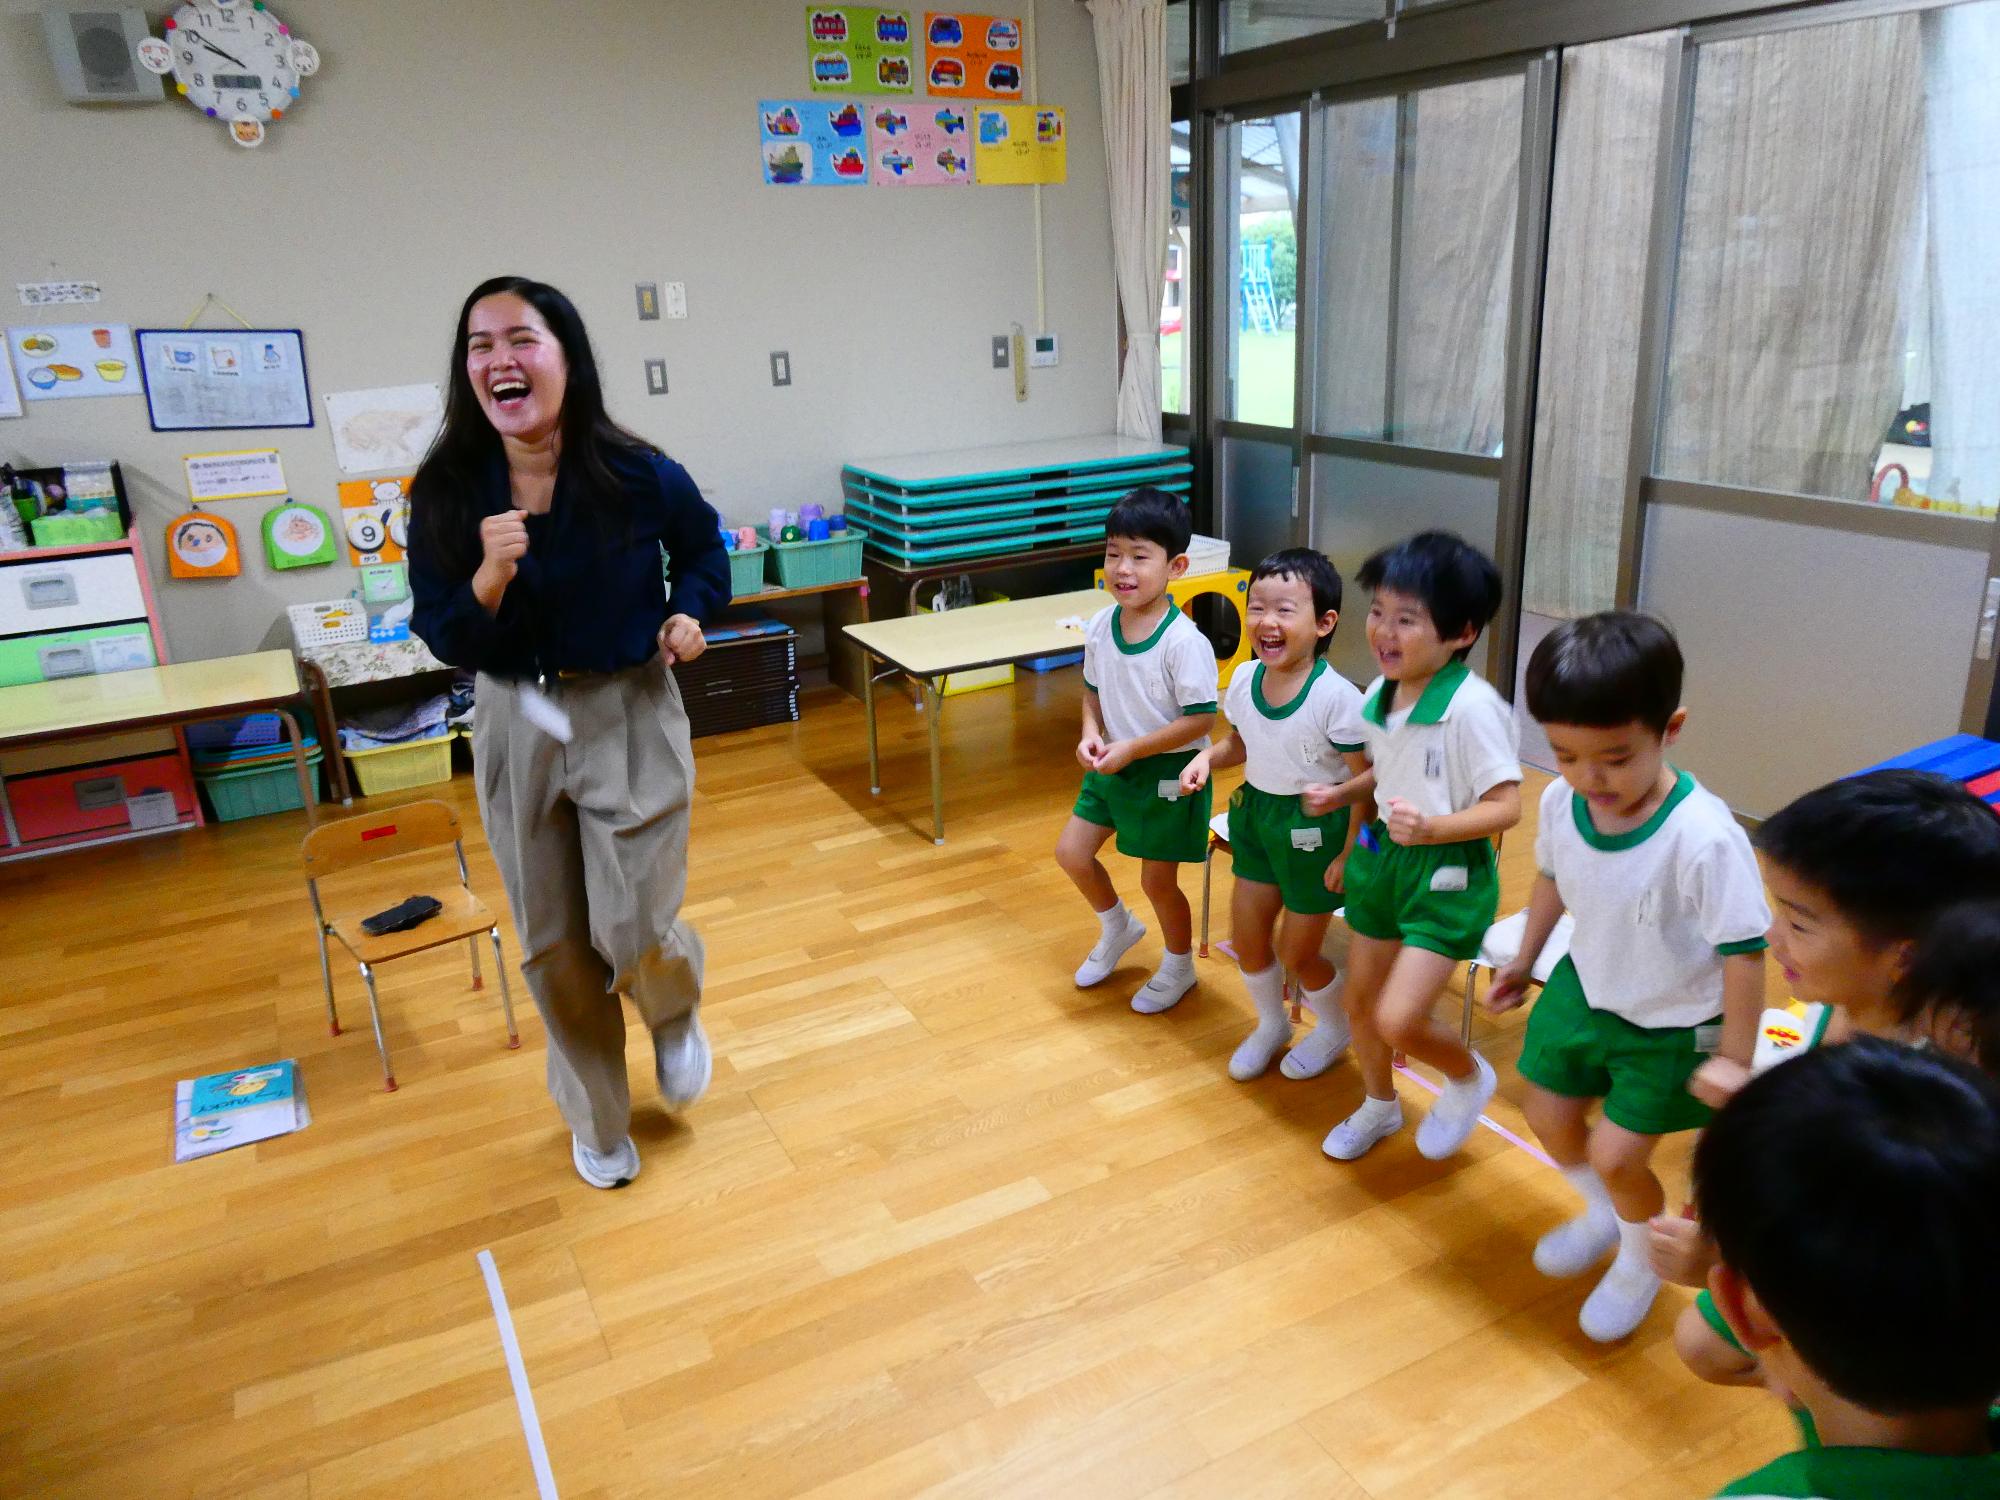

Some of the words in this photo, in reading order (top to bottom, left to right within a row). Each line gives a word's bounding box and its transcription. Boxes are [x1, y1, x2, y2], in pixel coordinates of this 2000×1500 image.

[198, 13, 212, 27] 11
[221, 8, 235, 23] 12
[248, 16, 255, 29] 1
[184, 29, 200, 44] 10
[264, 32, 274, 47] 2
[182, 50, 193, 65] 9
[275, 54, 285, 69] 3
[193, 73, 204, 87] 8
[271, 76, 281, 89] 4
[213, 90, 222, 105] 7
[236, 98, 247, 112] 6
[259, 92, 269, 107] 5
[361, 526, 376, 543] 9
